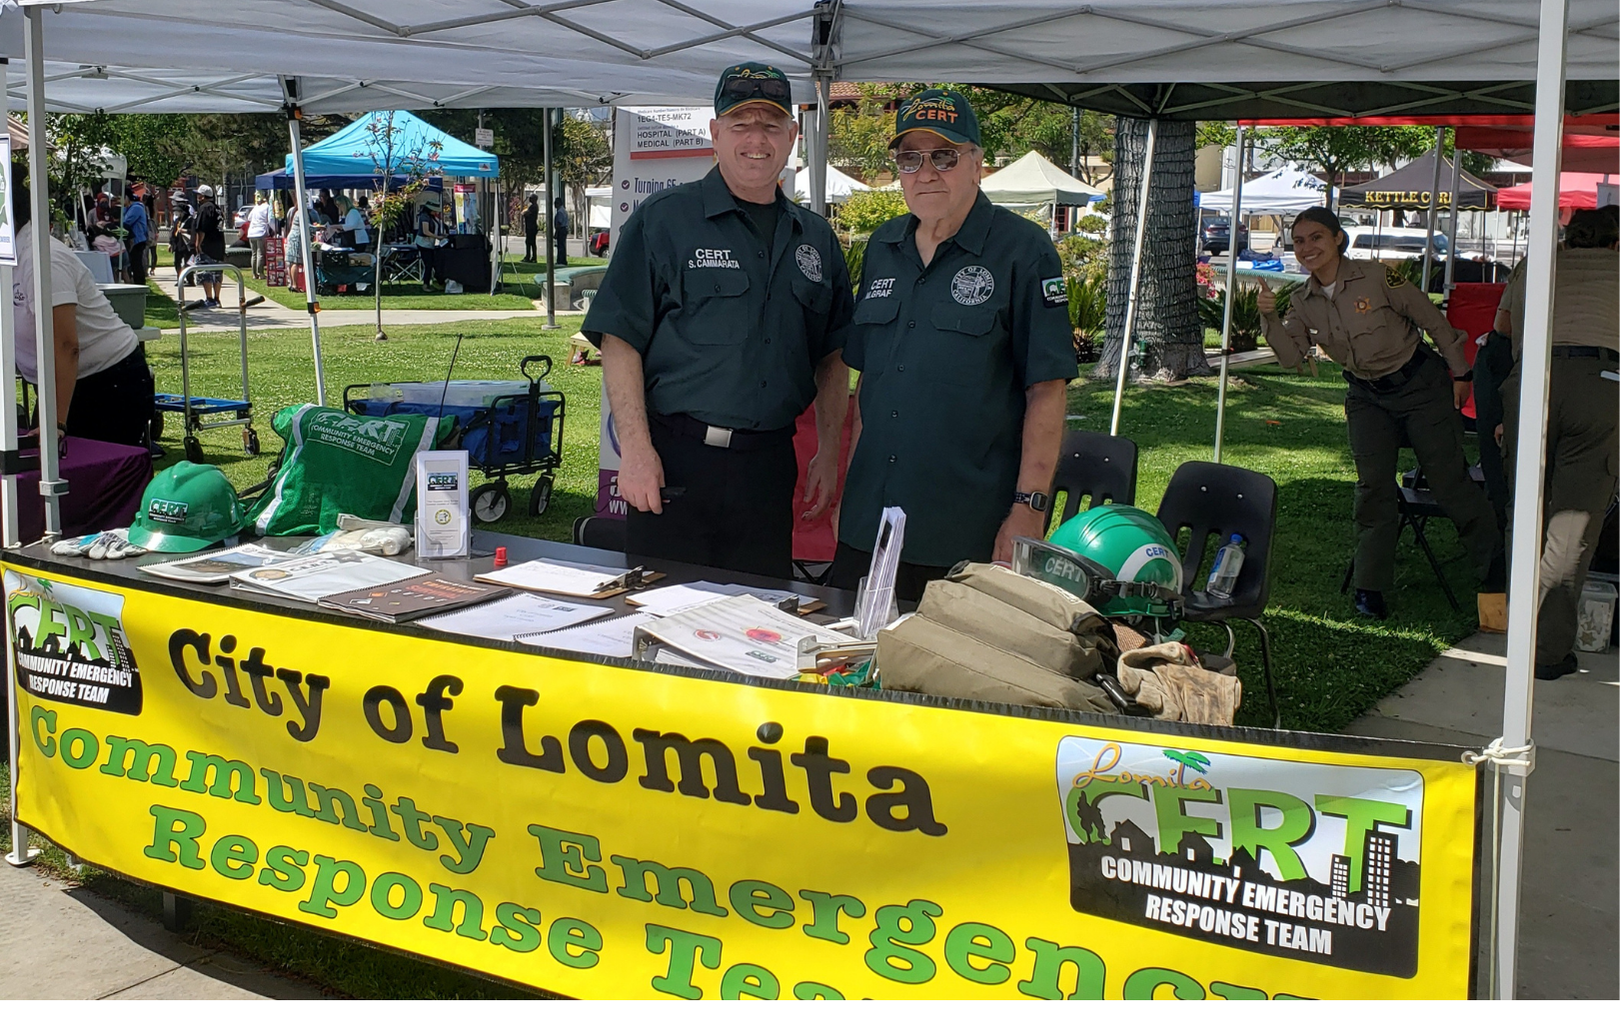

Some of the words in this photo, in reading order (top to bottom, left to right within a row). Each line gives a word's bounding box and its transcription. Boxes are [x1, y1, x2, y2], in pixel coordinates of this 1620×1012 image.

[902, 98, 956, 121] Lomita
[915, 109, 959, 124] CERT
[637, 130, 672, 139] HOSPITAL
[675, 129, 696, 138] (PART
[697, 128, 707, 136] A)
[637, 140, 670, 148] MEDICAL
[672, 138, 694, 147] (PART
[695, 138, 704, 146] B)
[634, 177, 664, 194] Turning
[1365, 190, 1419, 203] KETTLE
[1420, 191, 1452, 203] CR
[688, 259, 697, 268] S.
[696, 259, 740, 269] CAMMARATA
[695, 248, 731, 260] CERT
[870, 277, 896, 290] CERT
[953, 270, 966, 284] CITY
[979, 268, 993, 290] LOMITA
[952, 289, 987, 305] CALIFORNIA
[315, 412, 406, 443] CERT
[320, 433, 355, 449] RESPONSE
[355, 444, 375, 456] TEAM
[352, 435, 395, 456] EMERGENCY
[151, 500, 187, 516] CERT
[1145, 547, 1169, 558] CERT
[9, 594, 122, 665] CERT
[69, 662, 132, 688] EMERGENCY
[28, 674, 76, 699] RESPONSE
[77, 684, 110, 704] TEAM
[168, 628, 330, 743] City
[362, 674, 464, 754] of
[494, 684, 948, 837] Lomita
[1072, 743, 1214, 792] Lomita
[31, 704, 496, 875] Community
[1066, 775, 1413, 895] CERT
[144, 804, 603, 969] Response
[1101, 855, 1241, 904] COMMUNITY
[1242, 882, 1392, 931] EMERGENCY
[1145, 894, 1260, 942] RESPONSE
[1264, 918, 1332, 955] TEAM
